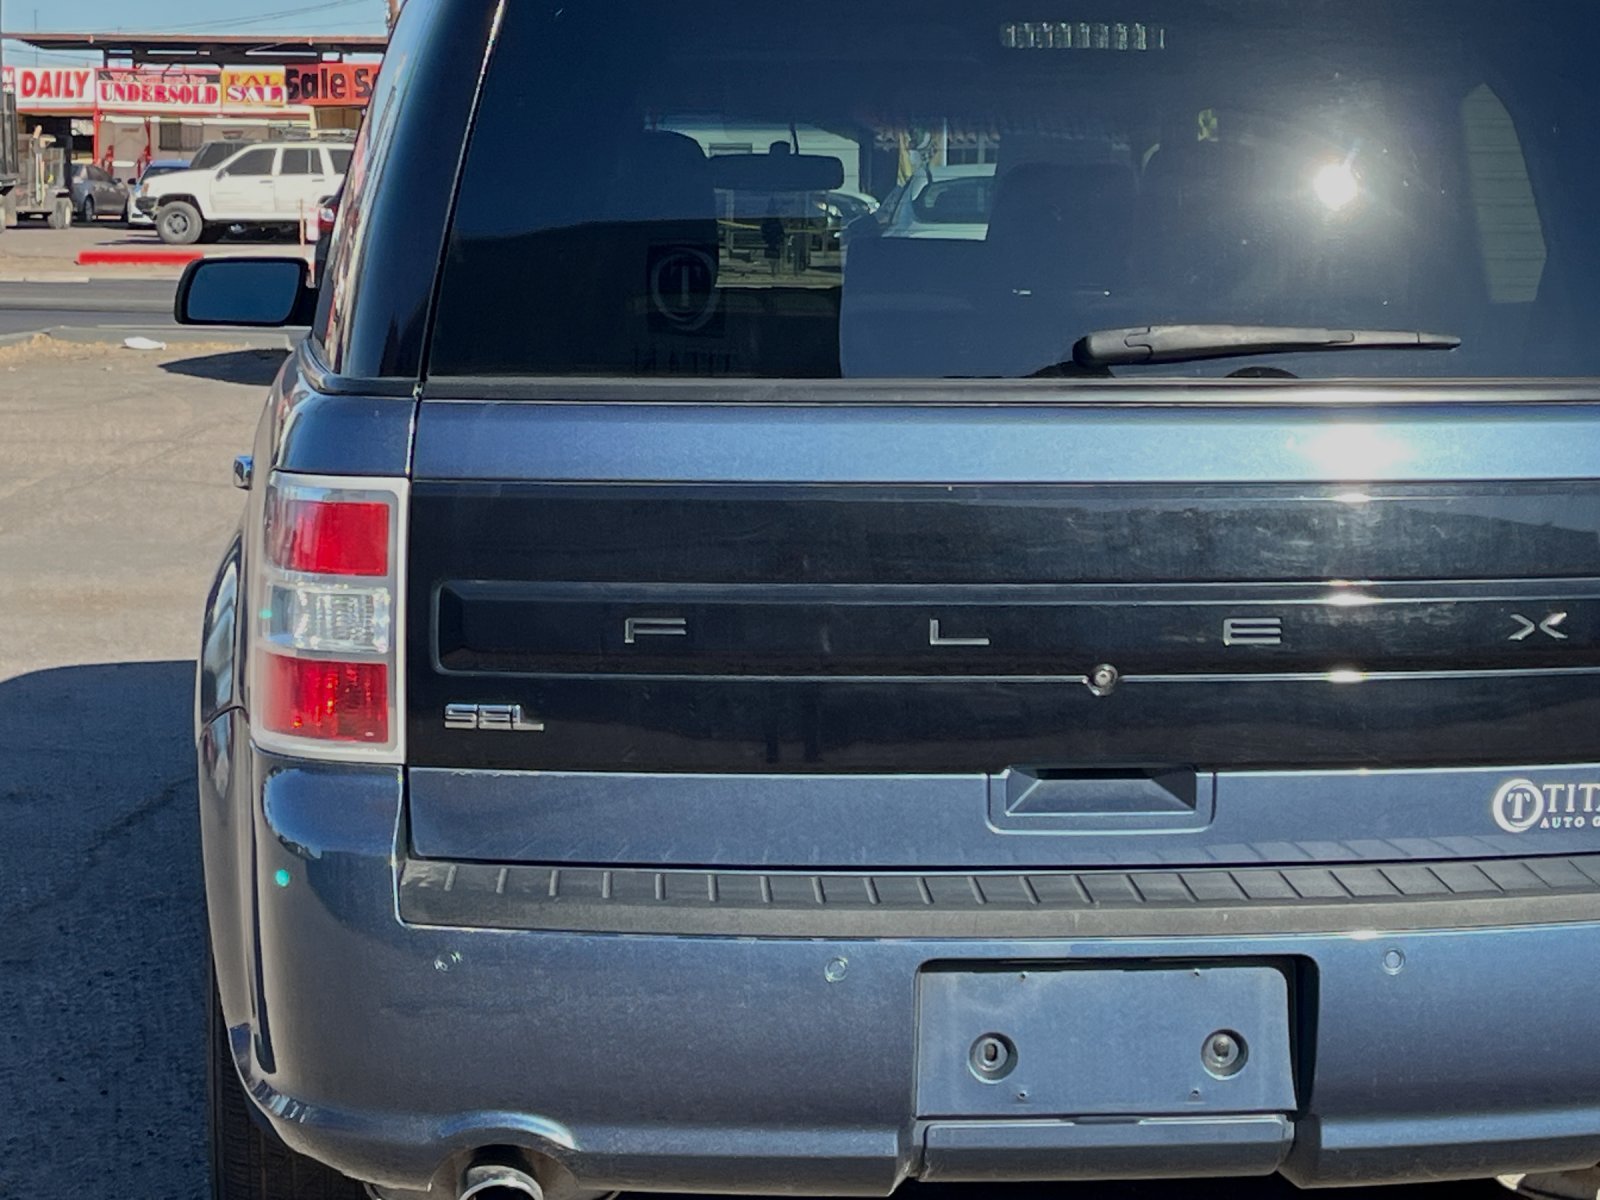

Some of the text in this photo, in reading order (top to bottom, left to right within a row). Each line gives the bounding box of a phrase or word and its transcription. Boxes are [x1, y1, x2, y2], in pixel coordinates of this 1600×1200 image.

[21, 70, 91, 98] DAILY
[100, 82, 218, 105] UNDERSOLD
[286, 68, 377, 99] Sale S
[445, 703, 544, 731] SEL
[1542, 783, 1600, 812] TIT
[1540, 816, 1585, 828] AUTO
